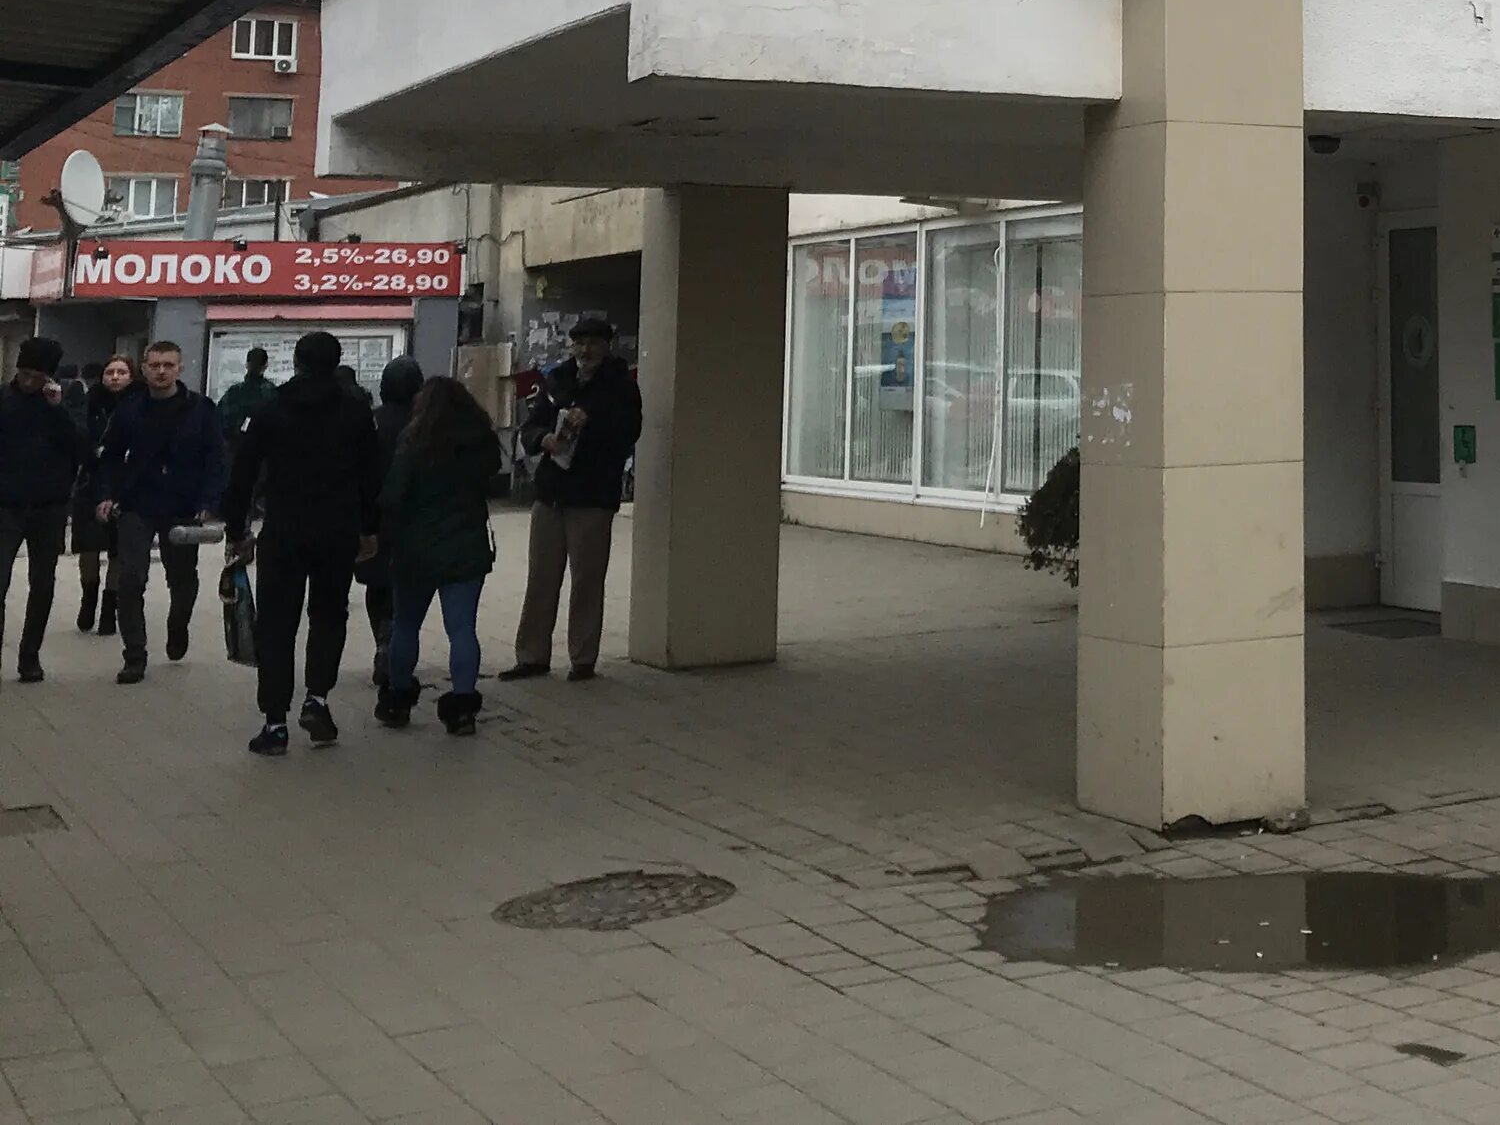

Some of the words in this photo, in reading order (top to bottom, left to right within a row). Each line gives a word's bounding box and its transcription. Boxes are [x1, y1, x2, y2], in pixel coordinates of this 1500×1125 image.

[293, 247, 450, 268] 2,5%-26,90
[75, 253, 272, 286] МОЛОКО
[292, 273, 450, 295] 3,2%-28,90
